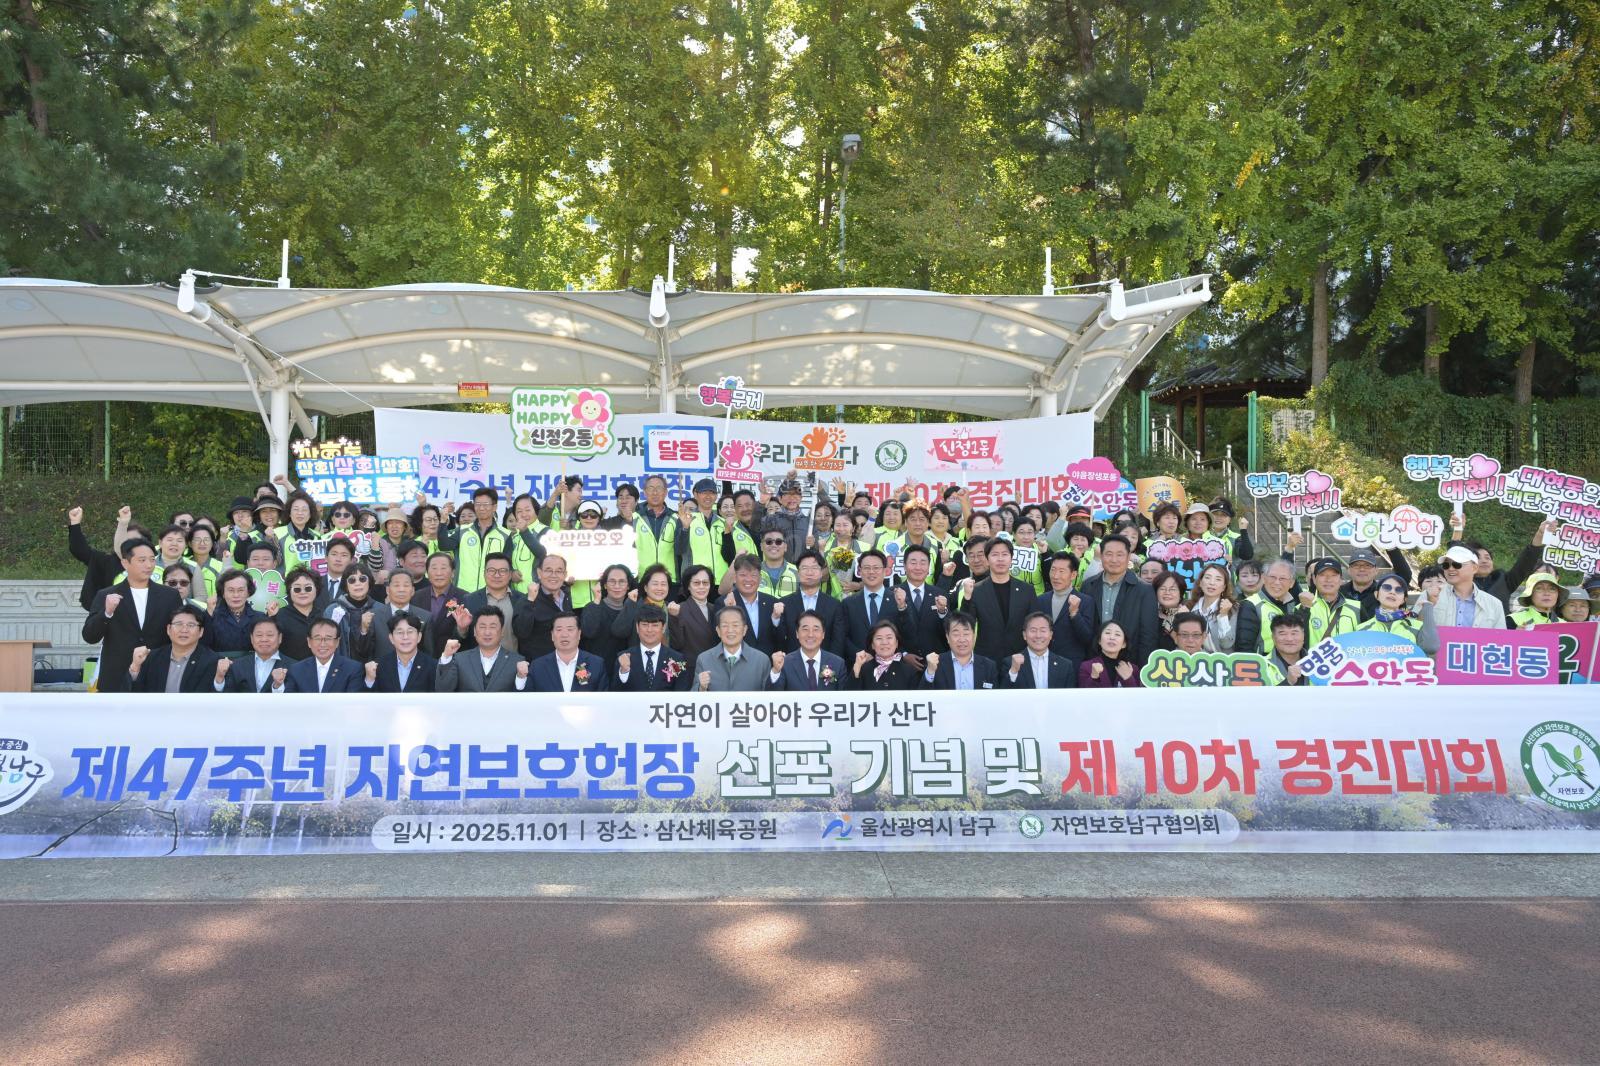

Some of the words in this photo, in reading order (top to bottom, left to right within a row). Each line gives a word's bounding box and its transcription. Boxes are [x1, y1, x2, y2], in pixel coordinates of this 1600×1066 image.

[516, 393, 571, 407] HAPPY
[516, 411, 571, 425] HAPPY
[530, 428, 593, 448] 신정2동
[939, 440, 990, 457] 신정1동
[658, 440, 700, 461] 달동
[429, 452, 483, 473] 신정5동
[560, 531, 624, 547] 삼삼오오
[1300, 640, 1344, 676] 명품
[1446, 642, 1551, 679] 대현동
[650, 702, 720, 728] 자연이
[729, 702, 802, 728] 살아야
[809, 701, 881, 728] 우리가
[888, 701, 937, 727] 산다
[61, 744, 326, 802] 제47주년
[345, 743, 699, 801] 자연보호헌장
[717, 738, 834, 797] 선포
[850, 738, 968, 797] 기념
[982, 738, 1043, 797] 및
[1060, 740, 1117, 795] 제
[1135, 739, 1260, 795] 10차
[1276, 739, 1507, 795] 경진대회
[1558, 787, 1585, 795] 자연보호
[392, 821, 432, 844] 일시
[451, 822, 567, 842] 2025.11.01
[597, 820, 637, 842] 장소
[655, 818, 777, 841] 삼산체육공원
[860, 816, 953, 837] 울산광역시
[959, 817, 996, 837] 남구
[1051, 814, 1220, 836] 자연보호남구협의회
